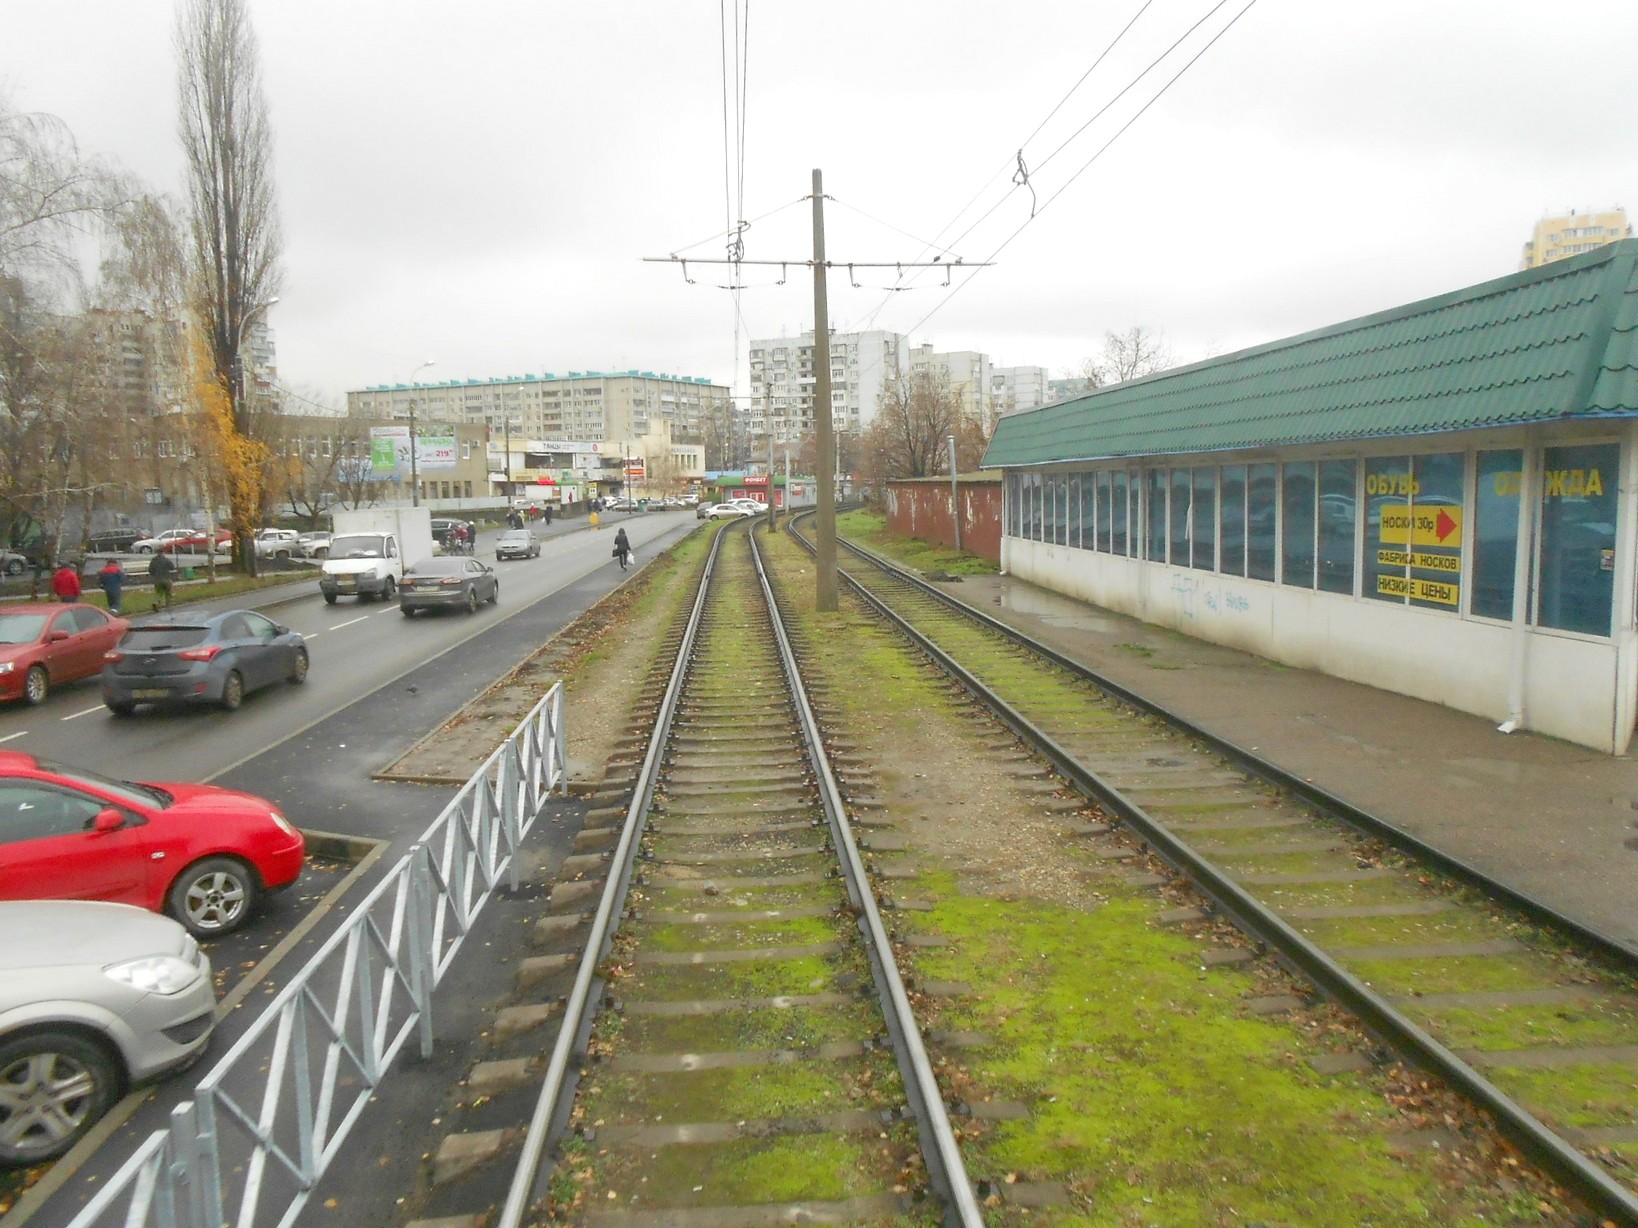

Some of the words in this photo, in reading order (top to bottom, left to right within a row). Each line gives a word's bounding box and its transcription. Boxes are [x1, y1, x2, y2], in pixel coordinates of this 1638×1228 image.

[1366, 473, 1420, 495] ОБУВЬ
[1420, 555, 1457, 570] НОСКОВ
[1378, 577, 1415, 595] НИЗКИЕ
[1421, 582, 1451, 601] ЦЕНЫ
